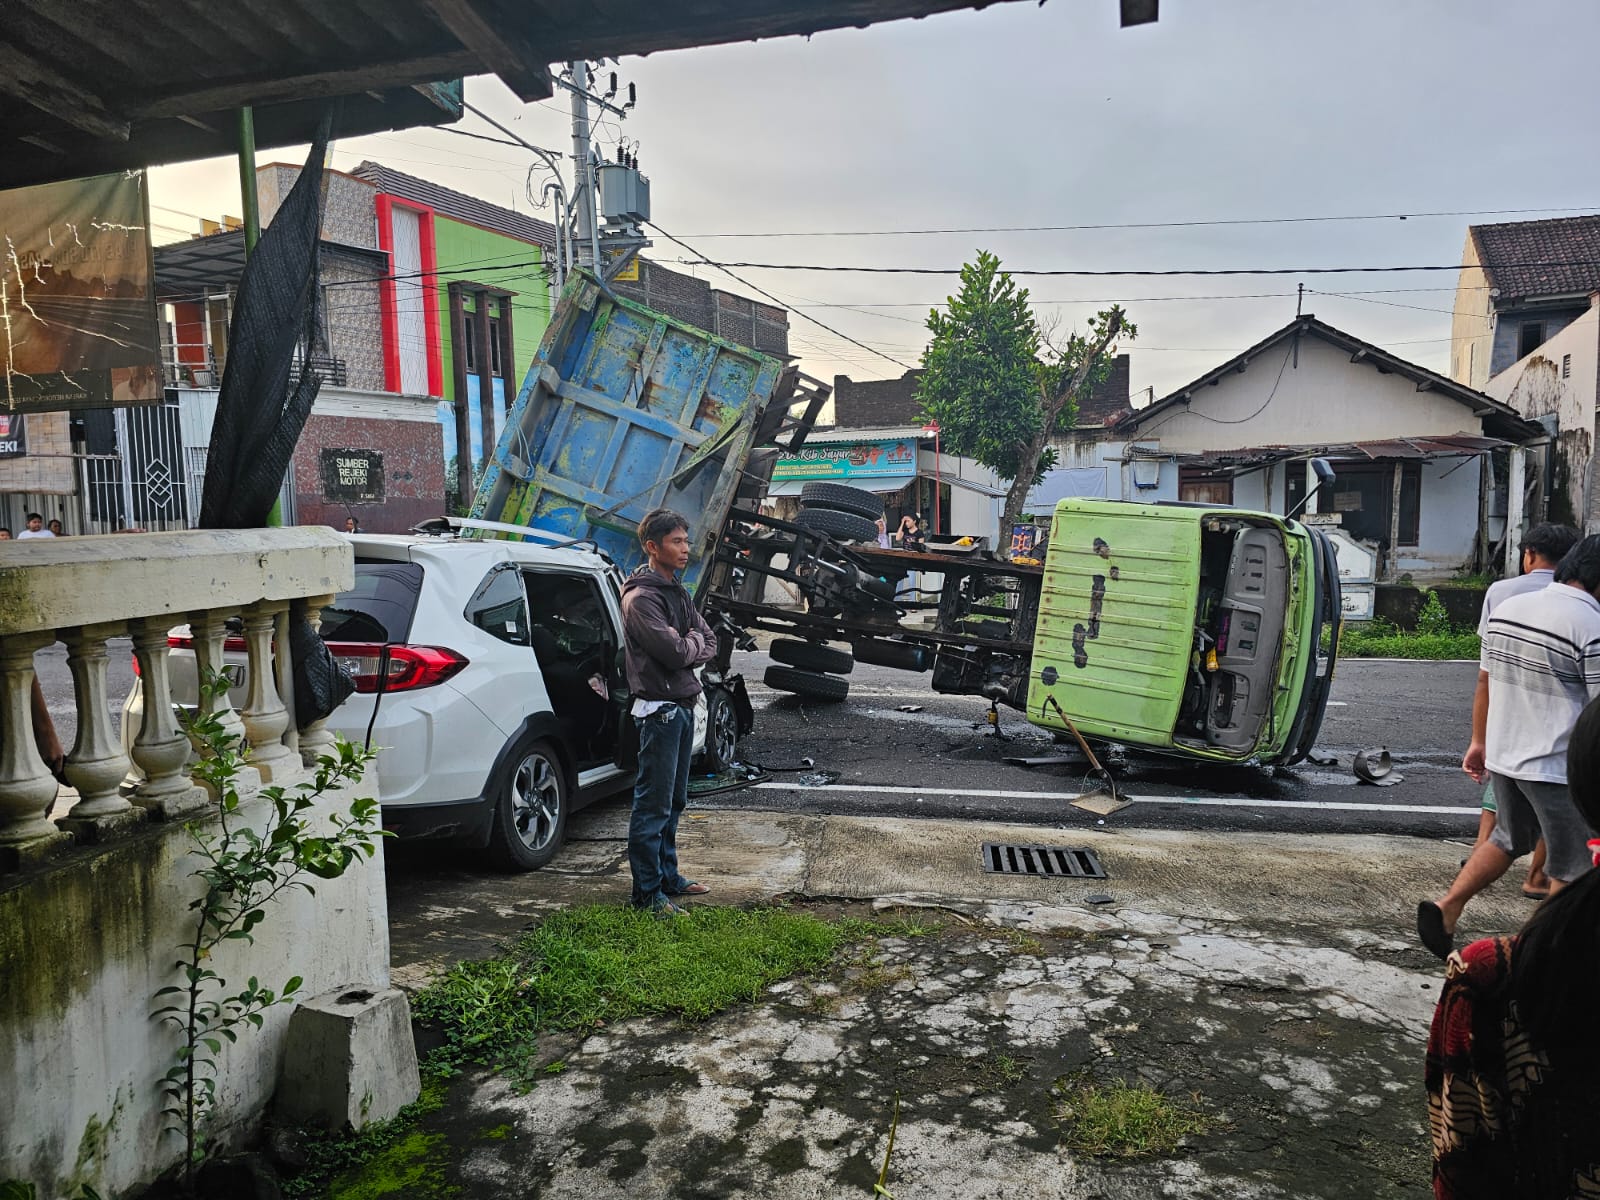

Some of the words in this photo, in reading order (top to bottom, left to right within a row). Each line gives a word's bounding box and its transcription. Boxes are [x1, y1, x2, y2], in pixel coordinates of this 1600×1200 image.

[819, 447, 850, 463] Sayur
[337, 458, 368, 469] SUMBER
[339, 468, 367, 476] REJEKI
[340, 477, 367, 485] MOTOR
